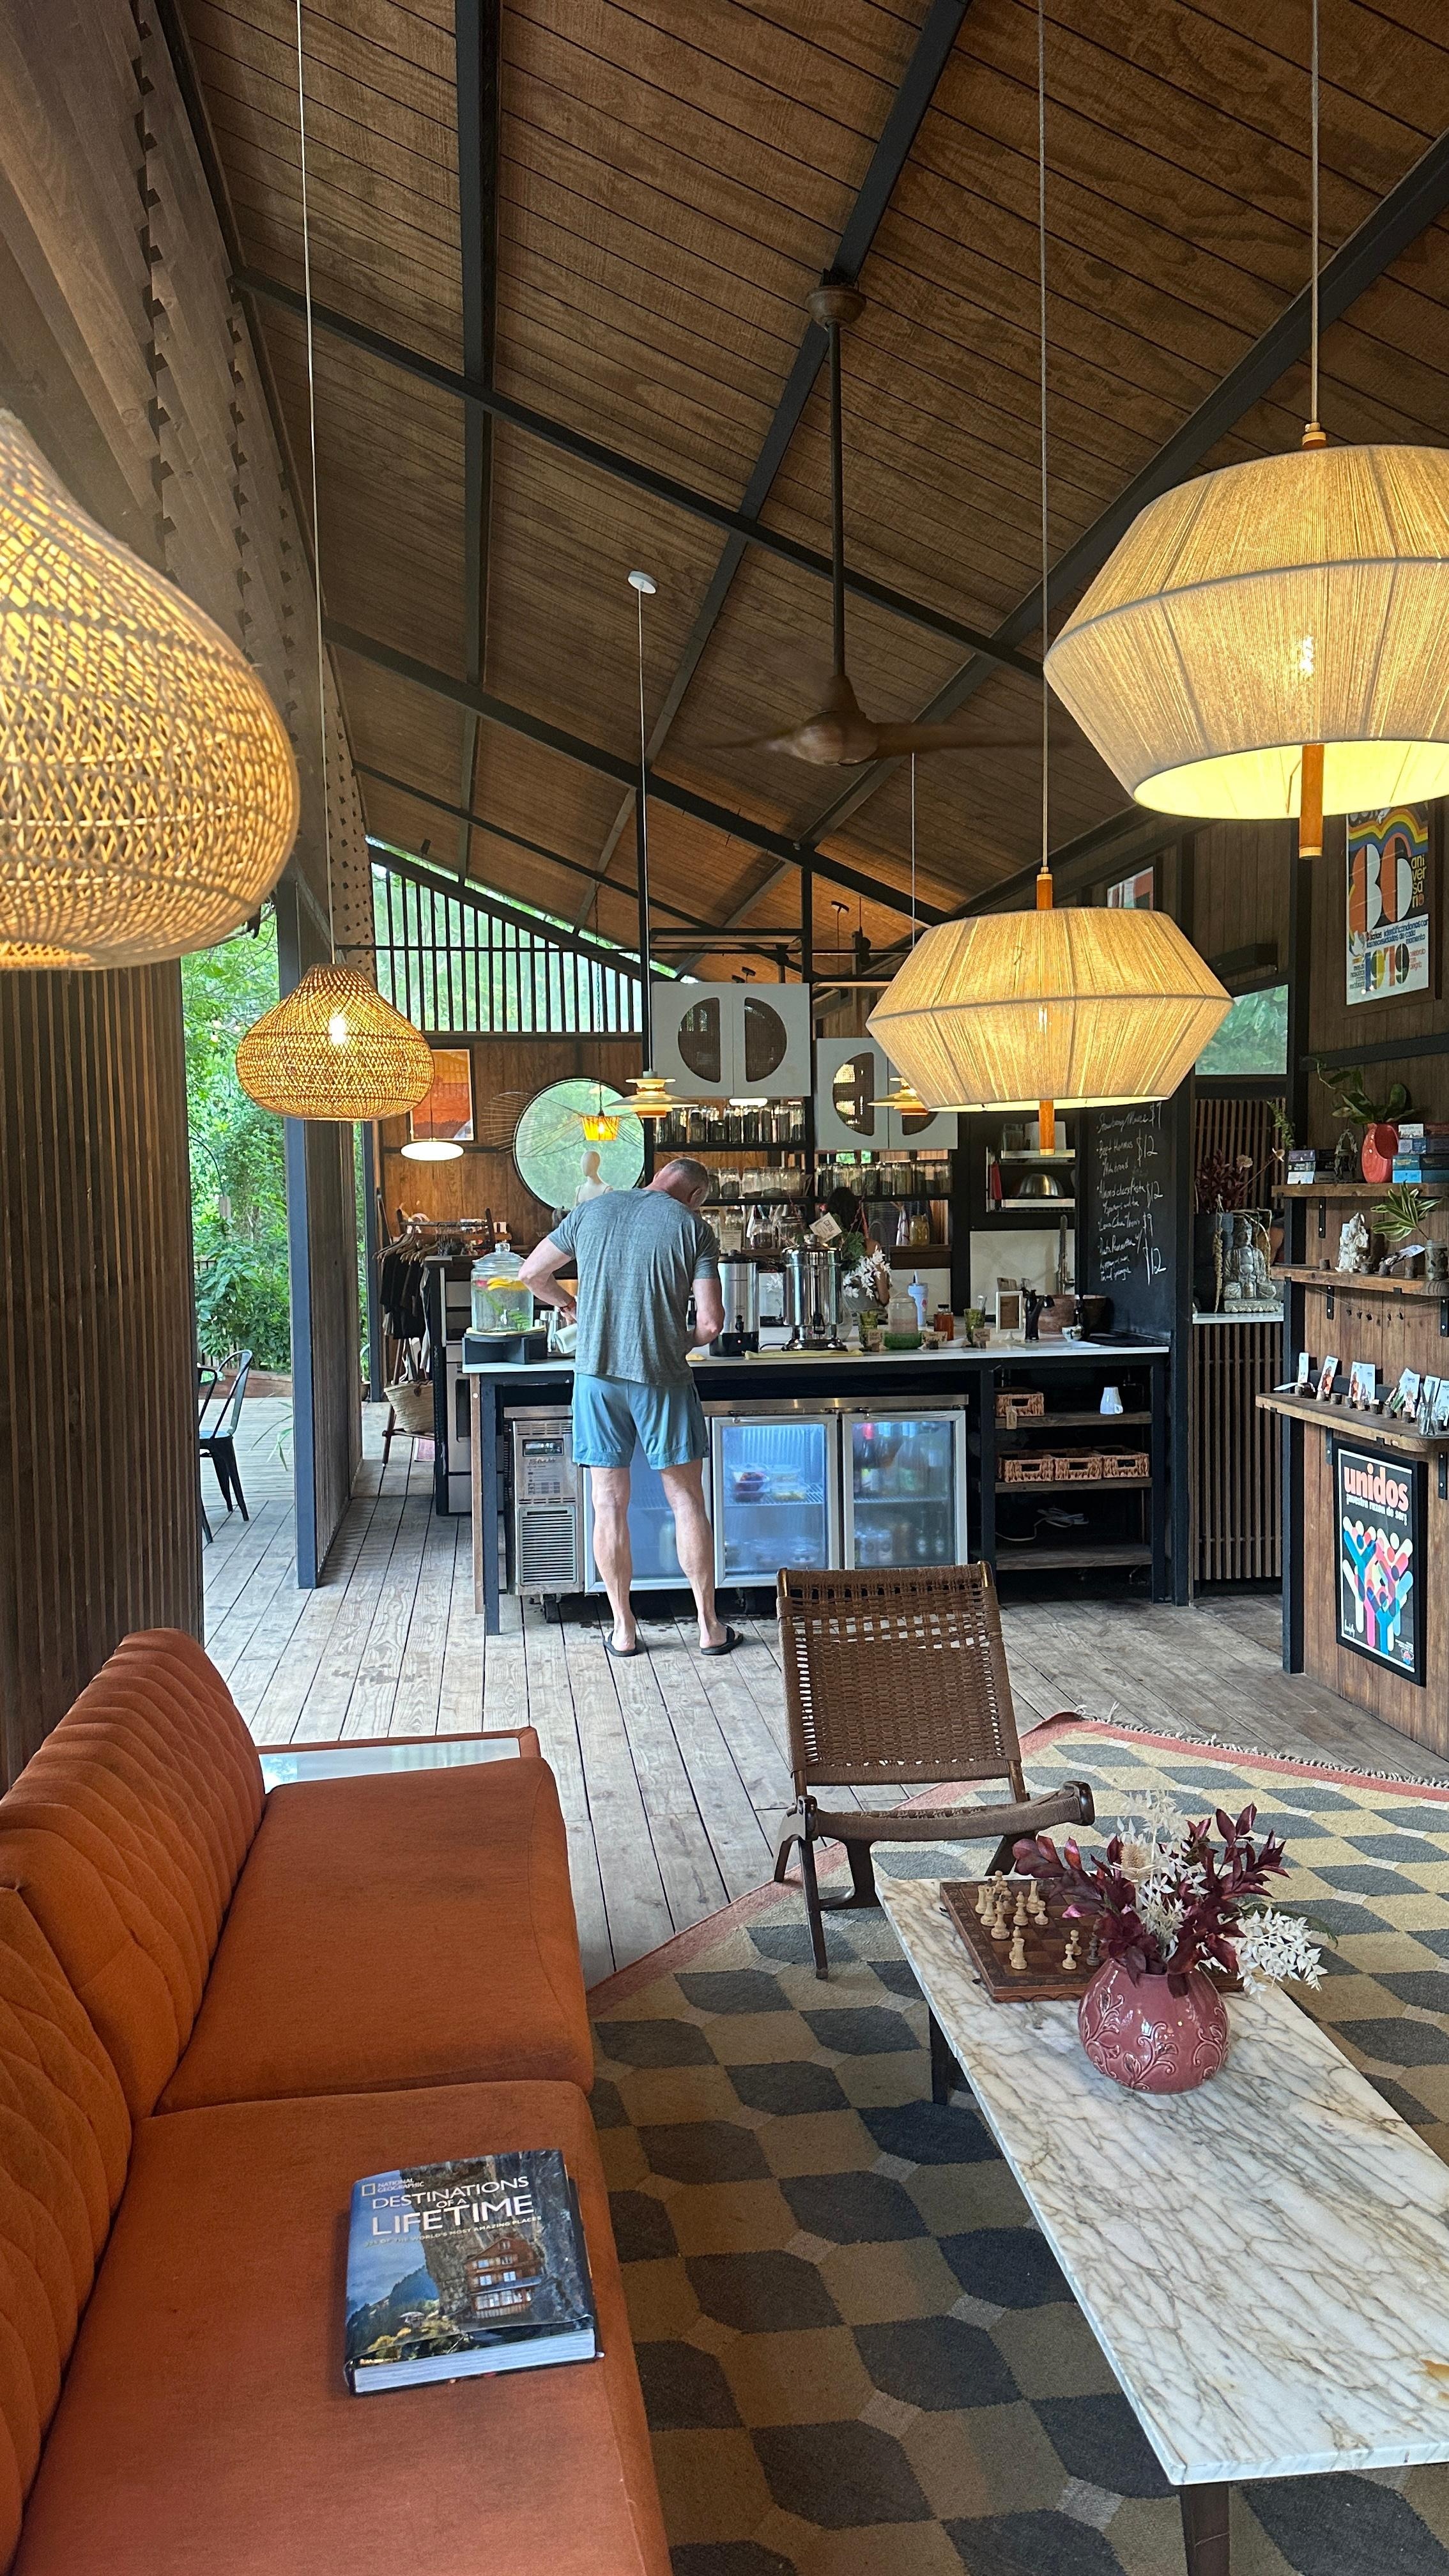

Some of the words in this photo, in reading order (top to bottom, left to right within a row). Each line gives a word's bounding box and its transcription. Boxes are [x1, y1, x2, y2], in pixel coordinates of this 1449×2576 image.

[1136, 1128, 1159, 1168] $12
[1344, 1462, 1409, 1512] unidos
[372, 2176, 529, 2209] DESTINATIONS
[377, 2181, 425, 2193] GEOGRAPHIC
[378, 2177, 415, 2188] NATIONAL
[372, 2194, 535, 2236] LIFETIME
[436, 2199, 454, 2209] OF
[411, 2232, 447, 2242] WORLD'S
[449, 2228, 471, 2236] MOST
[473, 2222, 512, 2234] AMAZING
[511, 2216, 542, 2227] PLACES
